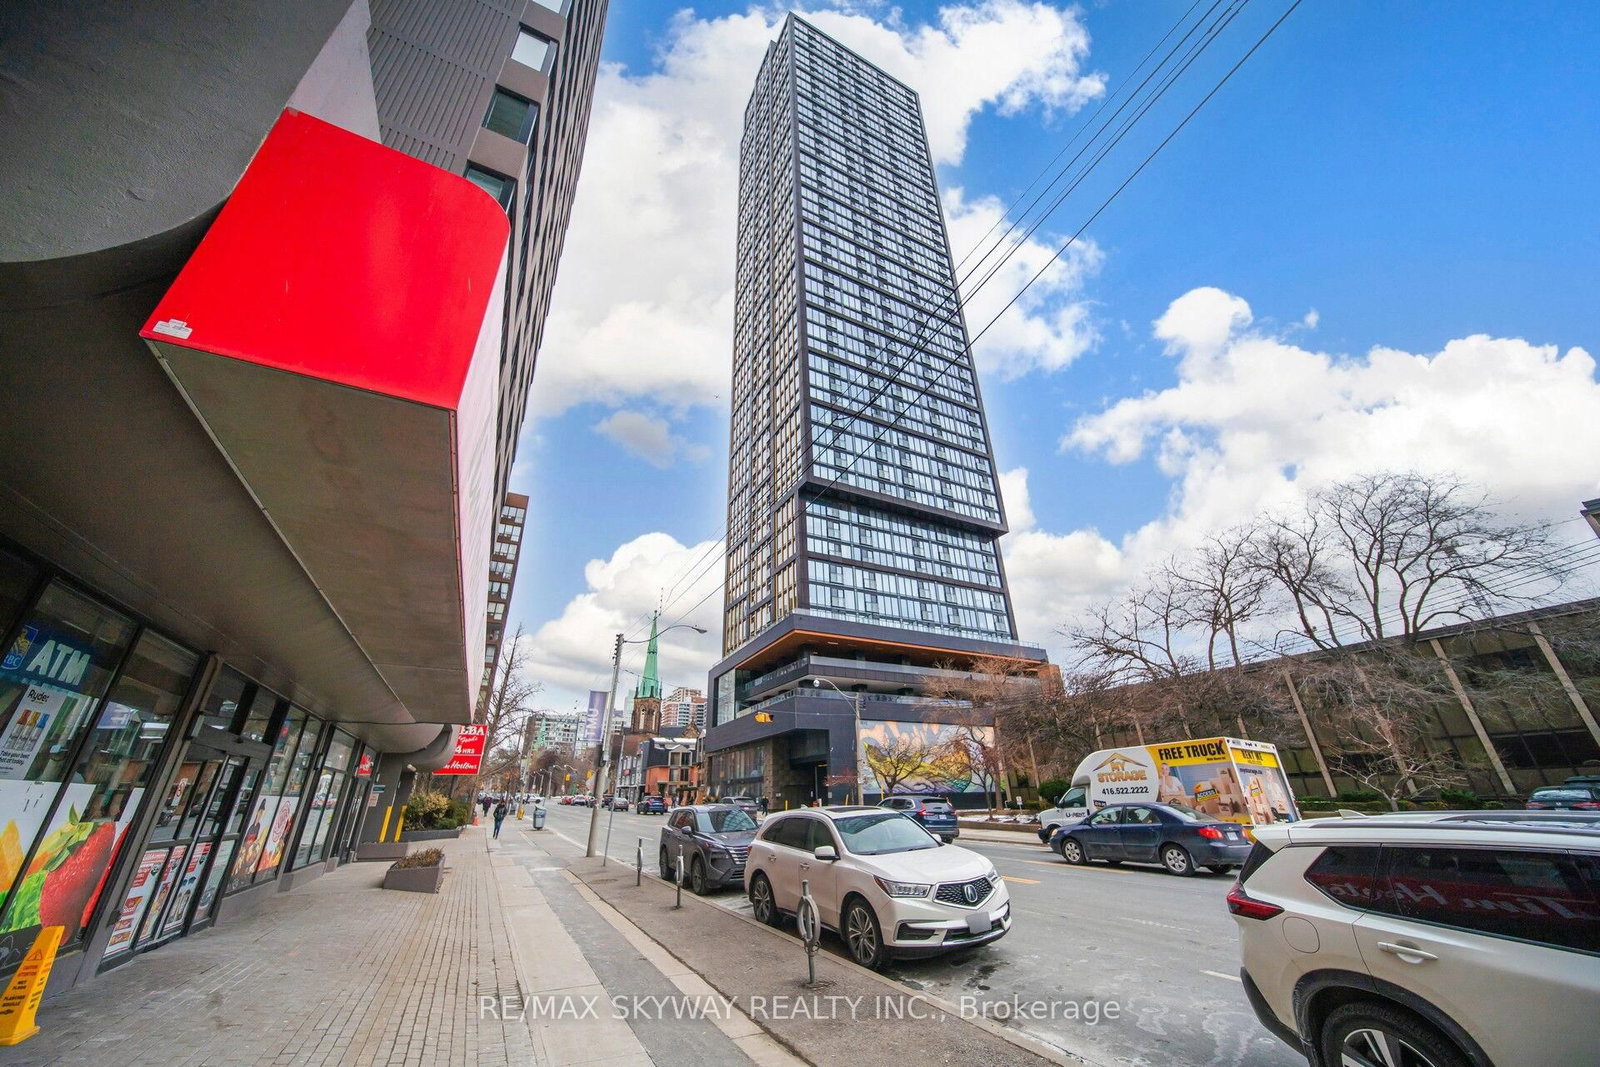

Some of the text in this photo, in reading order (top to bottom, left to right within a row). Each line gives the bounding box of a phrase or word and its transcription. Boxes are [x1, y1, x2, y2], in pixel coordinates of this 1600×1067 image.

[26, 640, 91, 686] ATM
[584, 708, 599, 738] TMU
[1158, 743, 1226, 760] FREE TRUCK
[1110, 762, 1126, 771] MY
[1097, 770, 1147, 783] STORAGE
[1102, 786, 1149, 795] 416.522.2222
